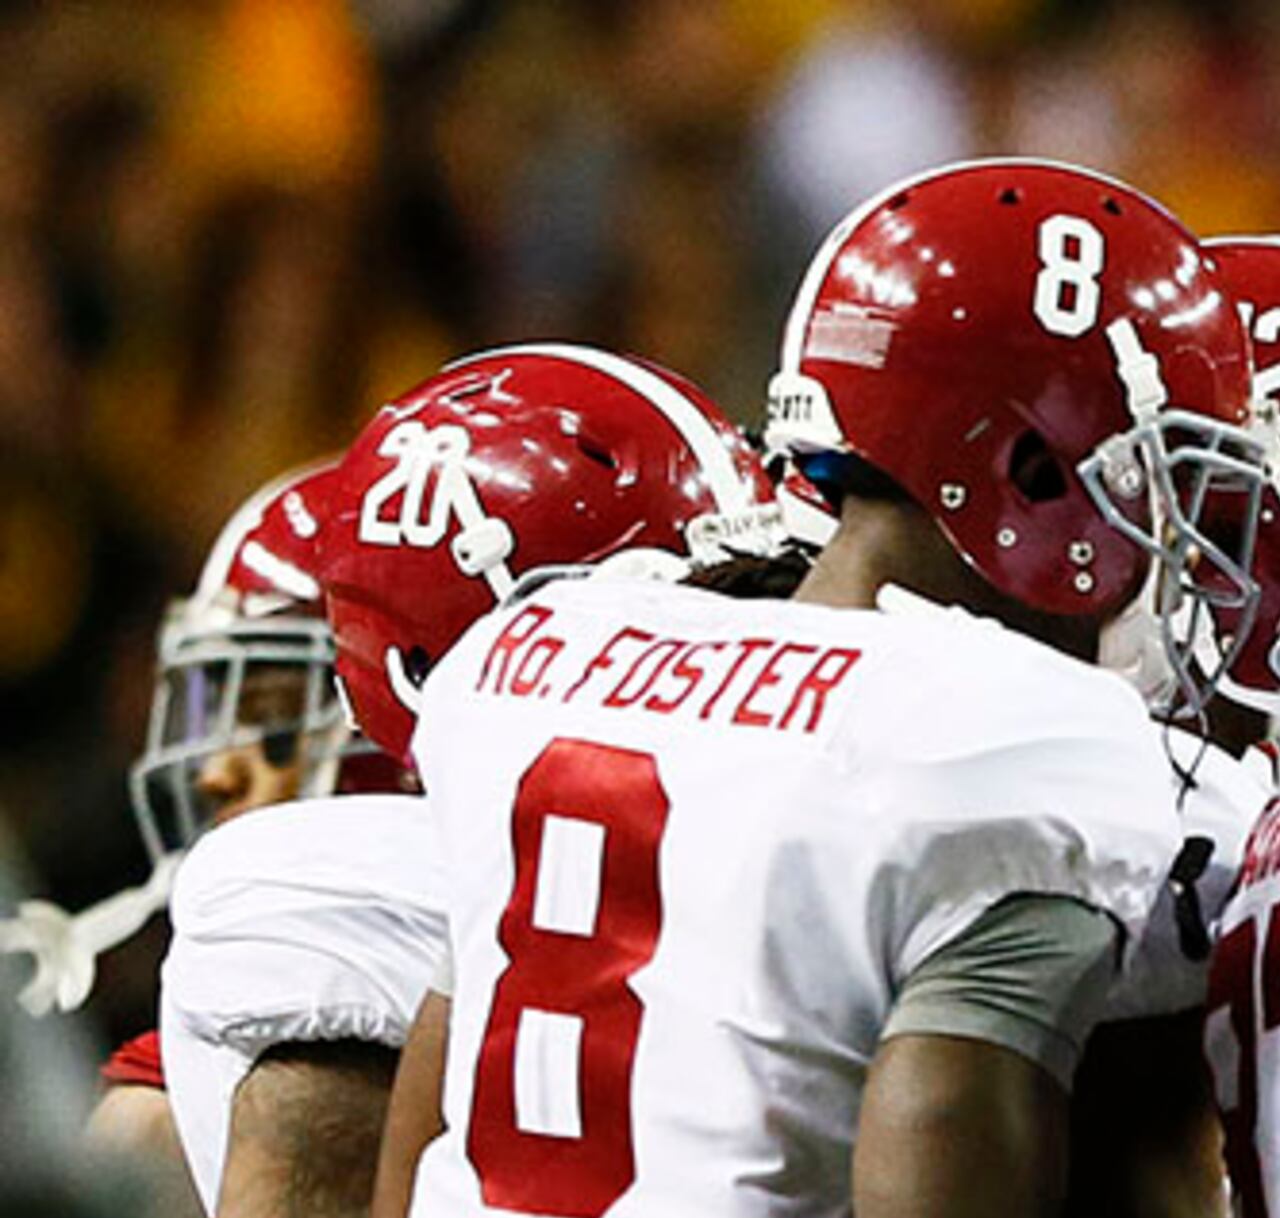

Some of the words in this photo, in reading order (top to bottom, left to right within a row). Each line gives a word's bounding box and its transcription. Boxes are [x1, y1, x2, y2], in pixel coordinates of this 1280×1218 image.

[1033, 214, 1103, 337] 8
[359, 420, 471, 547] 20
[476, 604, 565, 698] Ro.
[562, 626, 862, 733] FOSTER
